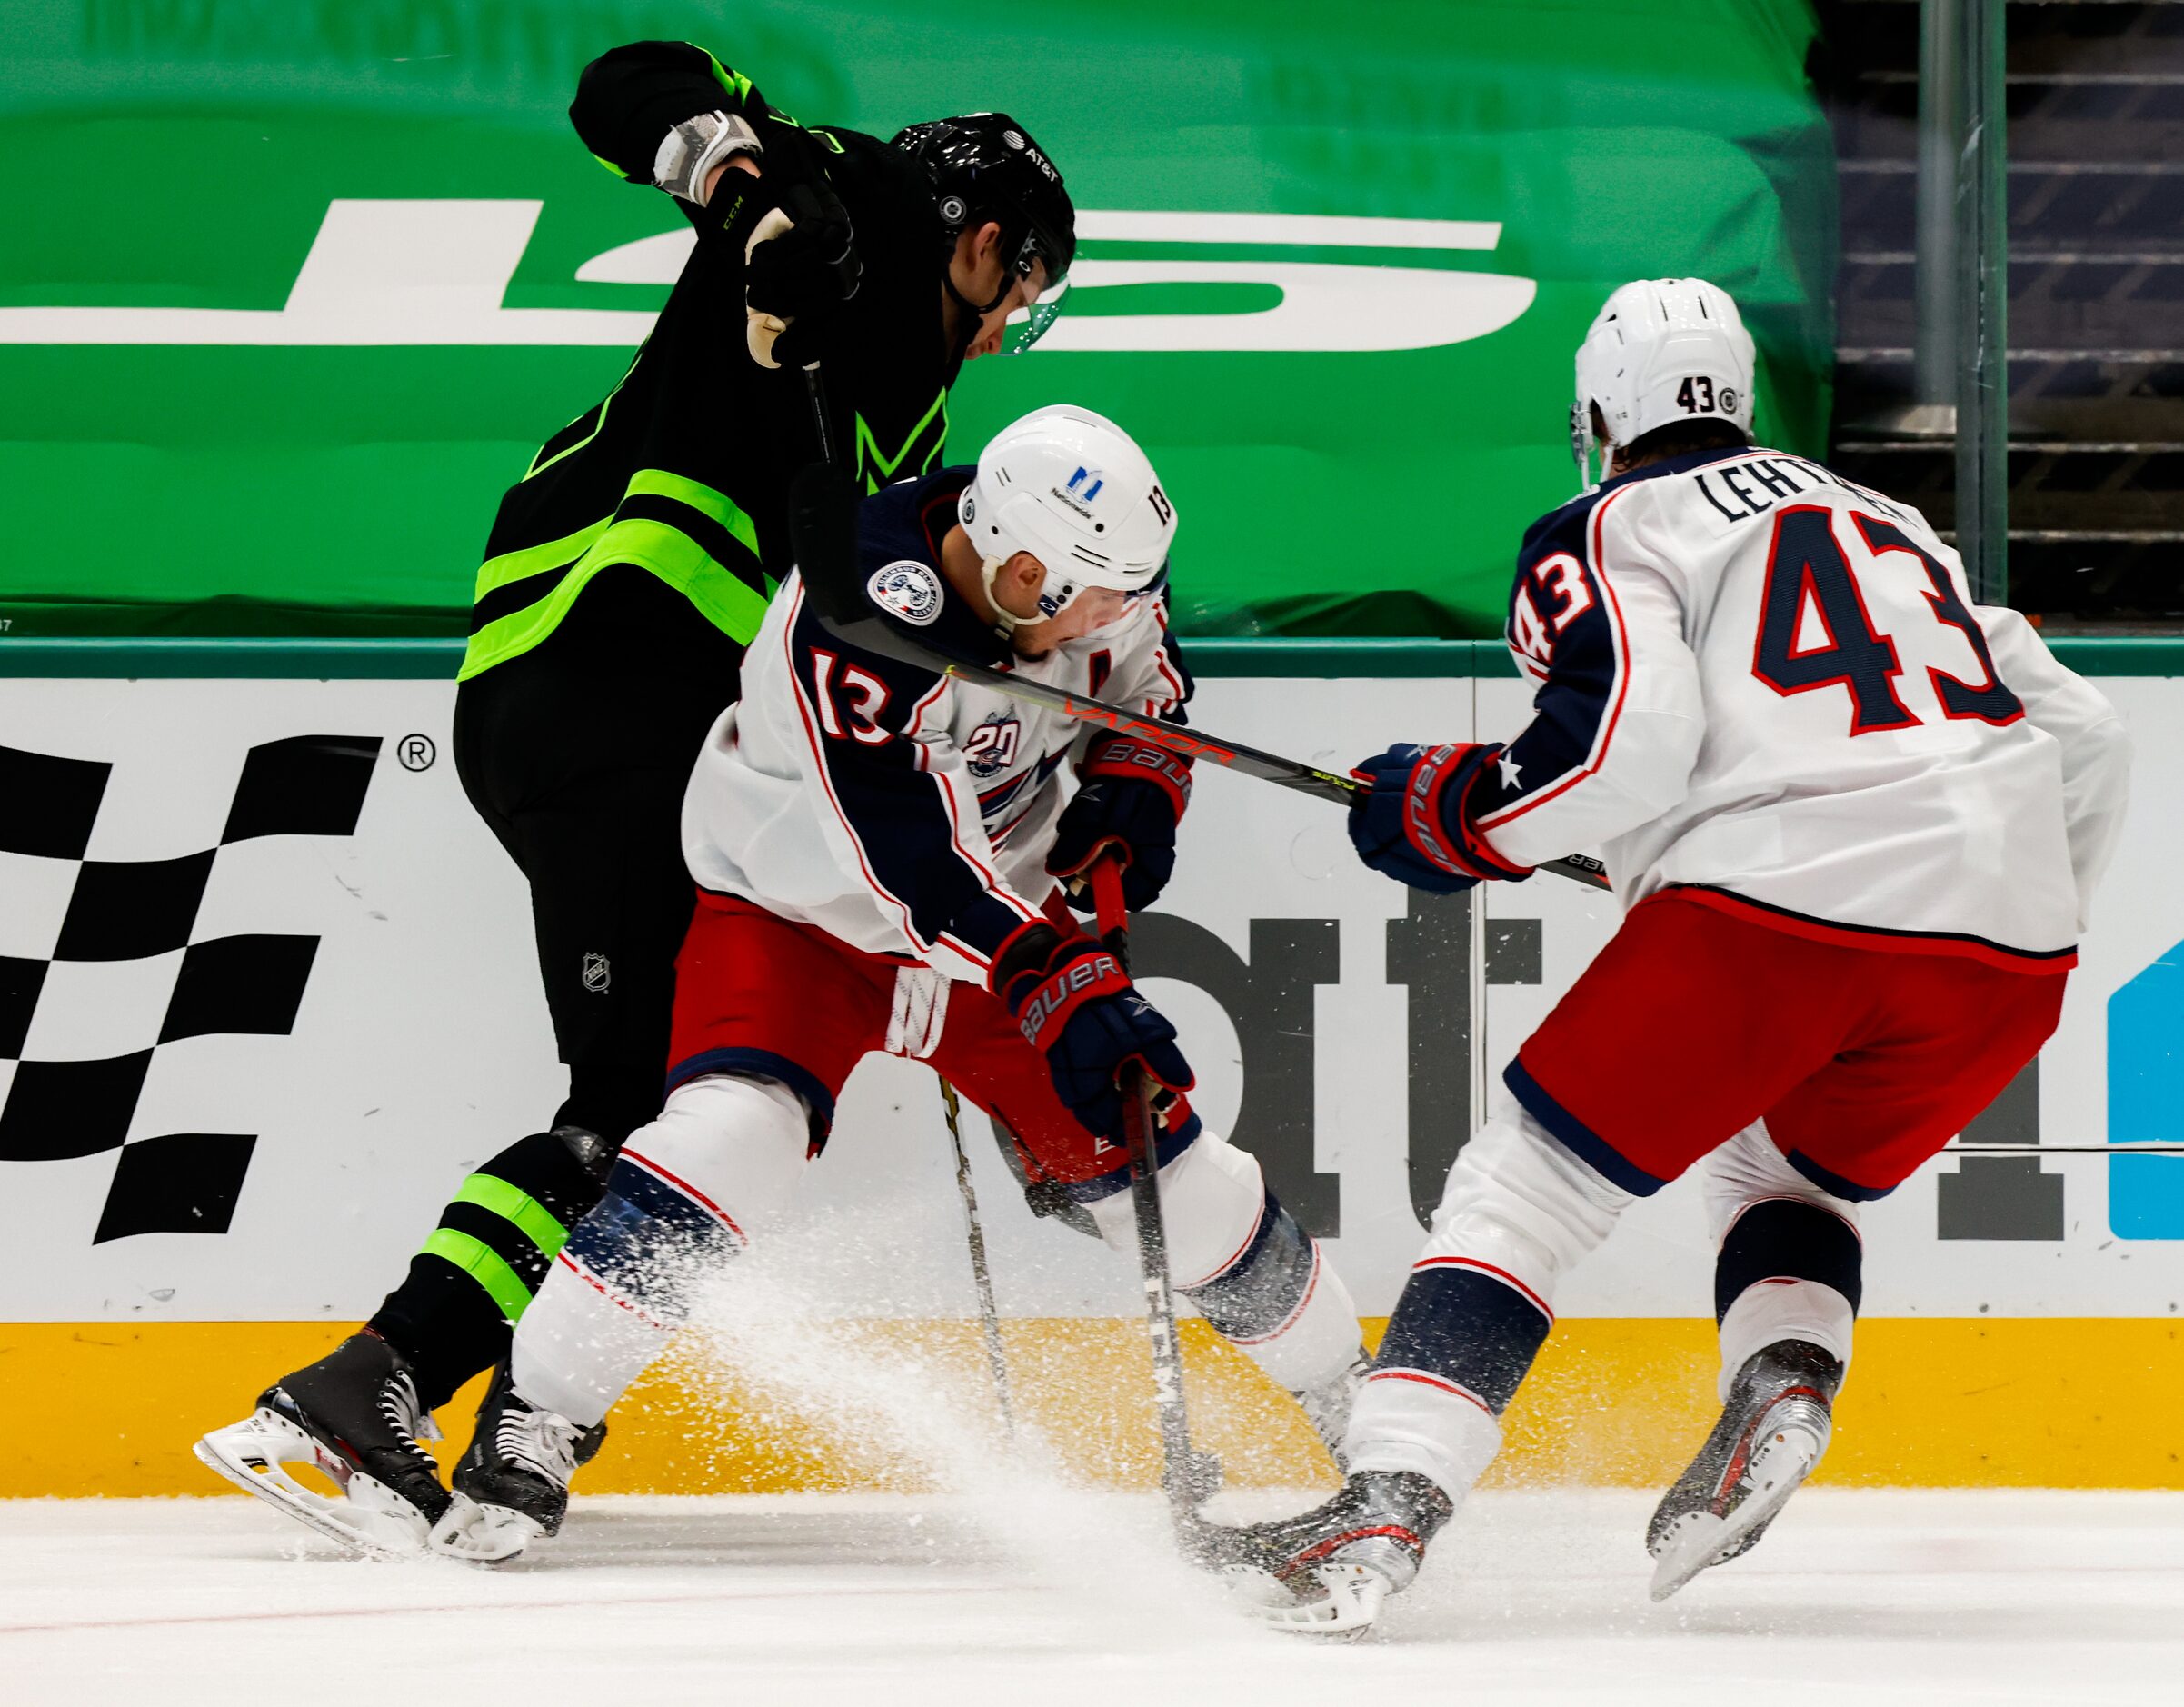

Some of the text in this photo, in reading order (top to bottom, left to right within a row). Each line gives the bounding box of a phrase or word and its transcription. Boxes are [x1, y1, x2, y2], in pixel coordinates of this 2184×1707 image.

[1025, 148, 1059, 182] AT&T
[723, 195, 743, 231] CCM
[1676, 375, 1716, 414] 43
[1050, 487, 1094, 520] Nationwide
[1147, 484, 1171, 527] 13
[1513, 551, 1596, 666] 43
[1751, 504, 2025, 737] 43
[809, 645, 895, 747] 13
[962, 720, 1021, 767] 20
[1064, 696, 1237, 768] VAPOR
[1020, 956, 1120, 1046] BAUER
